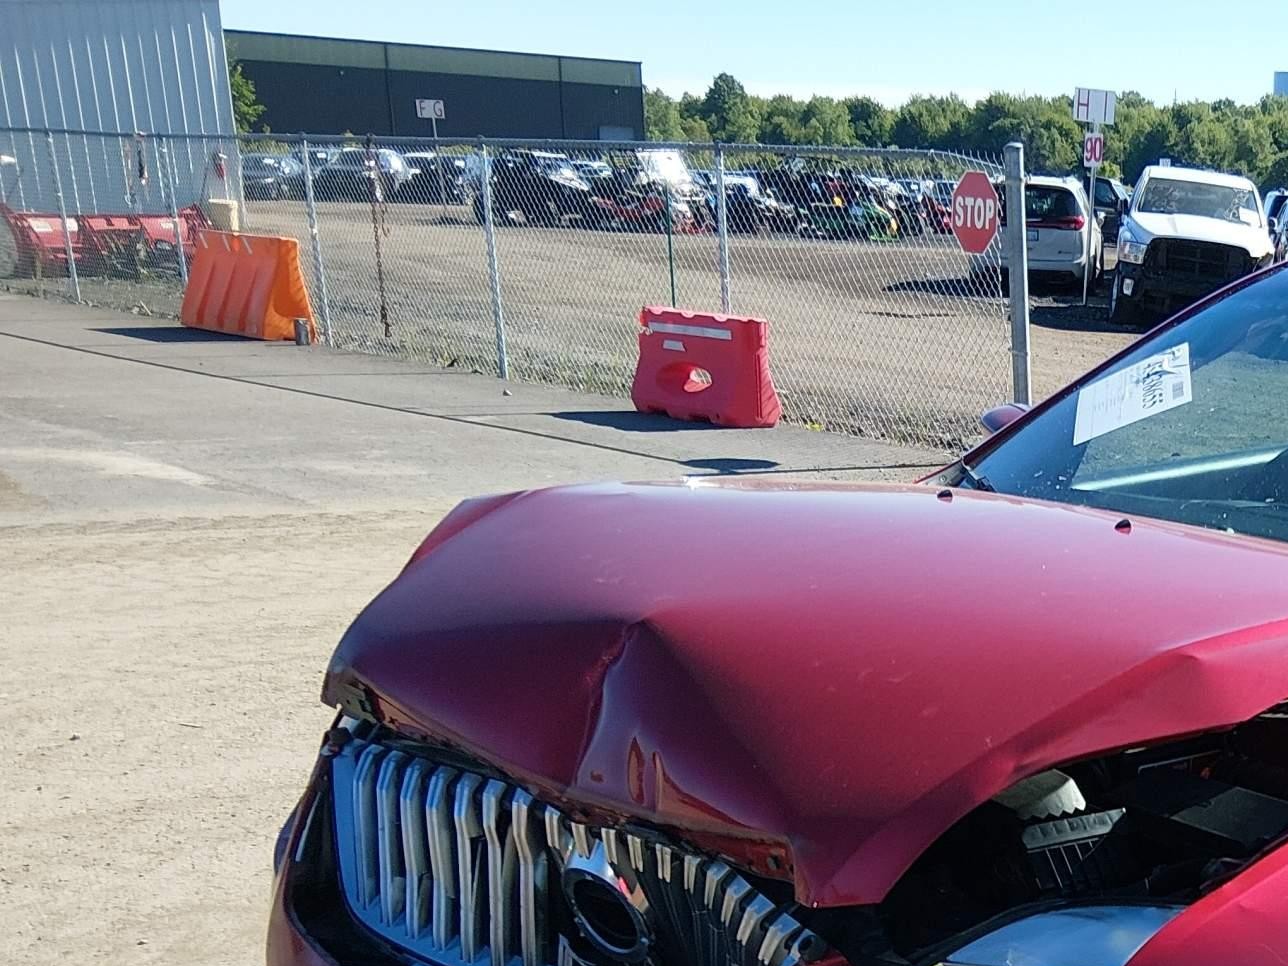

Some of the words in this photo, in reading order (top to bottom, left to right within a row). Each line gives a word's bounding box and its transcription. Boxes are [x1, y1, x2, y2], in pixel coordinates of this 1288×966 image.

[419, 100, 426, 117] F
[433, 100, 443, 117] G
[1077, 88, 1090, 121] H
[1085, 137, 1102, 163] 90
[955, 196, 994, 229] STOP
